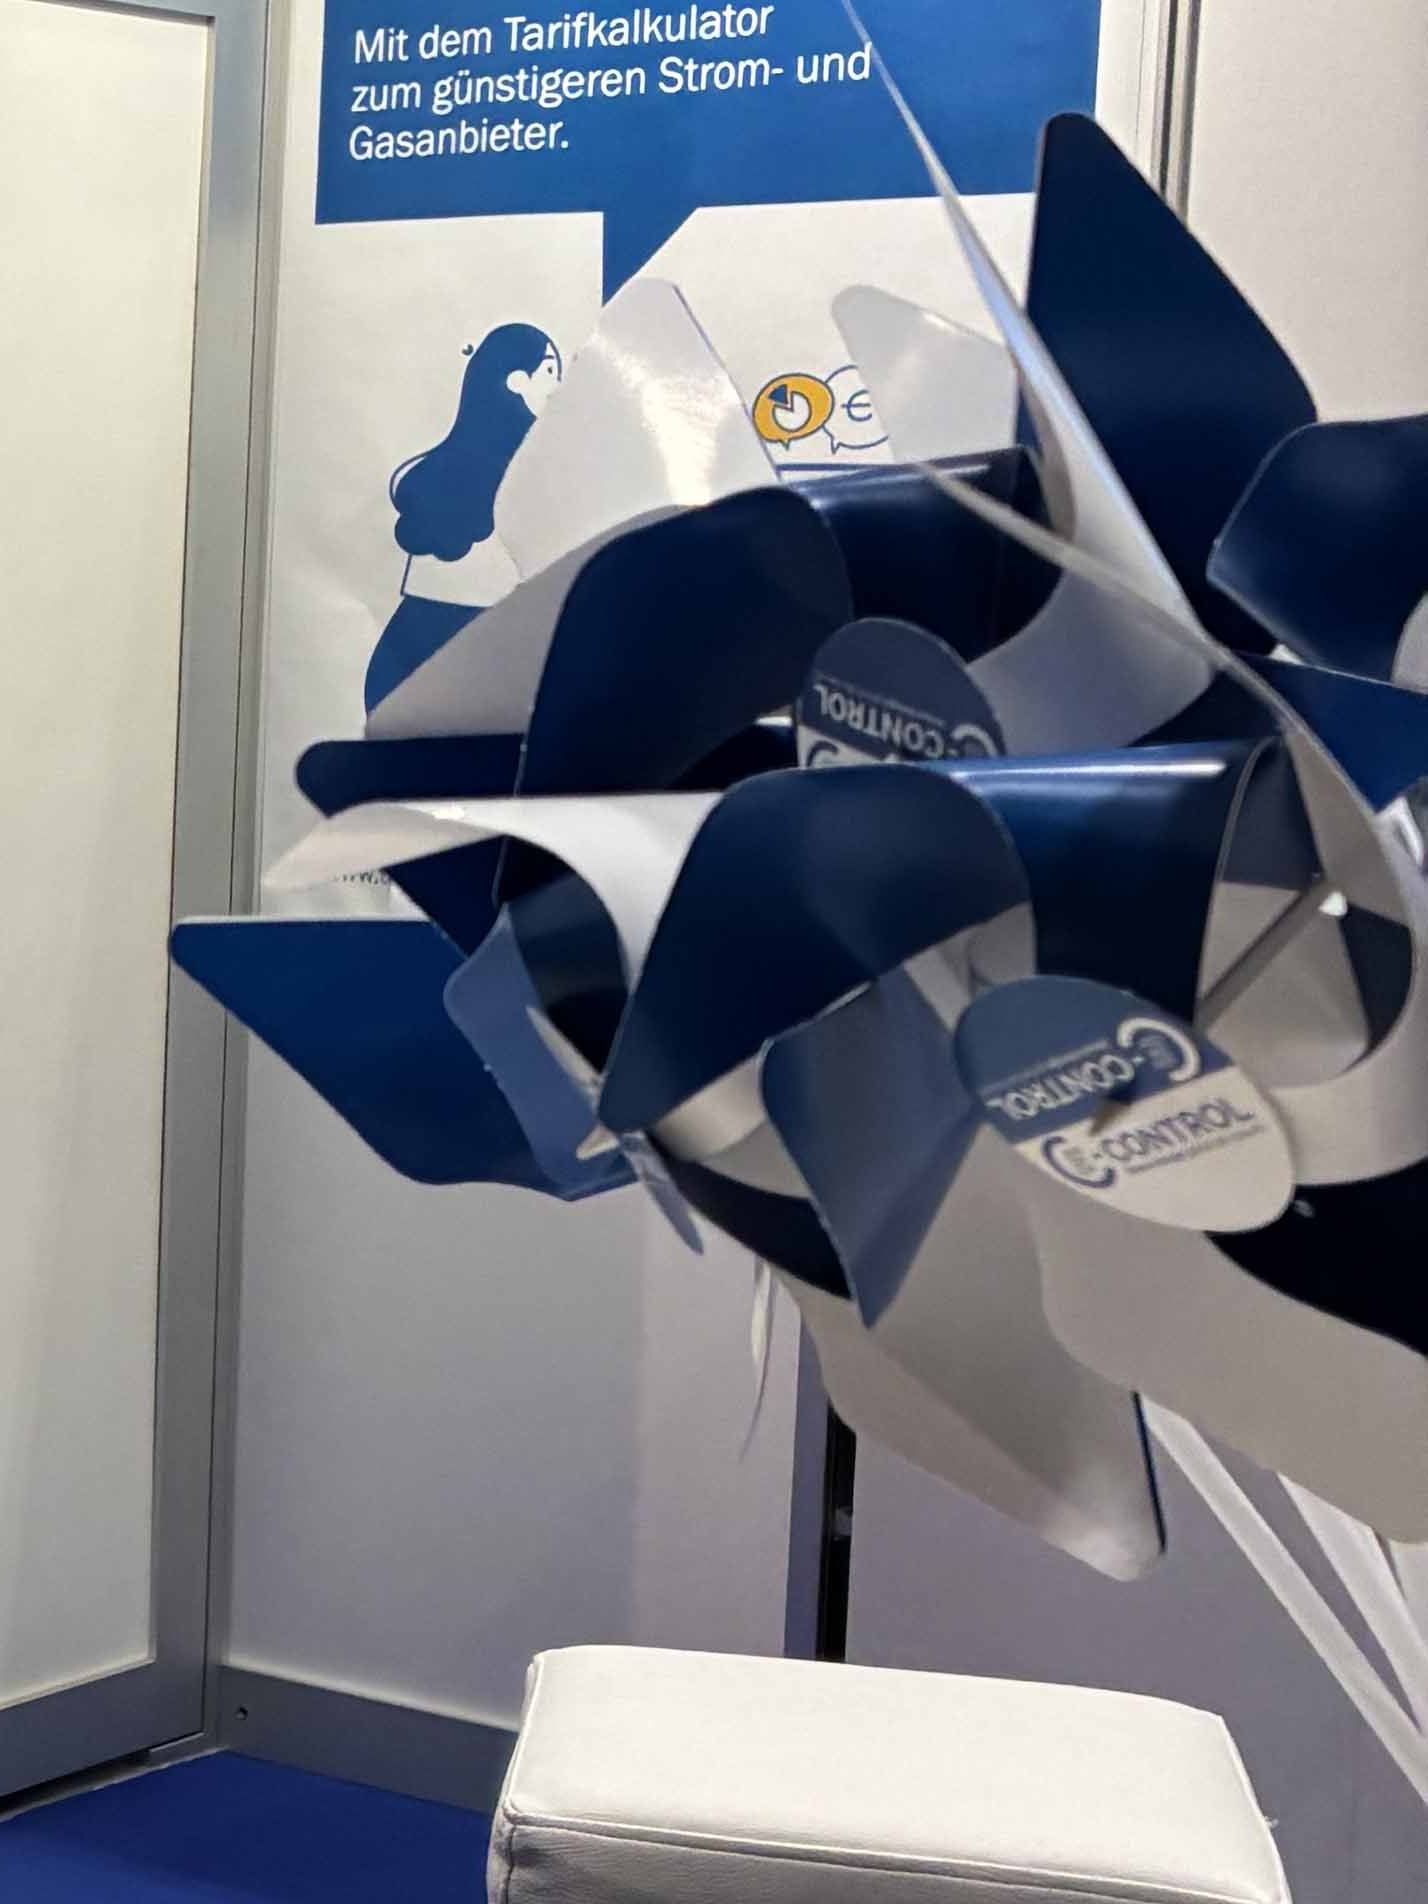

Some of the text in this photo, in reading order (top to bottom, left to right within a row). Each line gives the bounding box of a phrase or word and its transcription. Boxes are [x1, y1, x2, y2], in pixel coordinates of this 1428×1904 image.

[355, 2, 774, 64] Mit dem Tarifkalkulator
[351, 42, 872, 114] zum günstigeren Strom- und
[349, 119, 569, 161] Gasanbieter.
